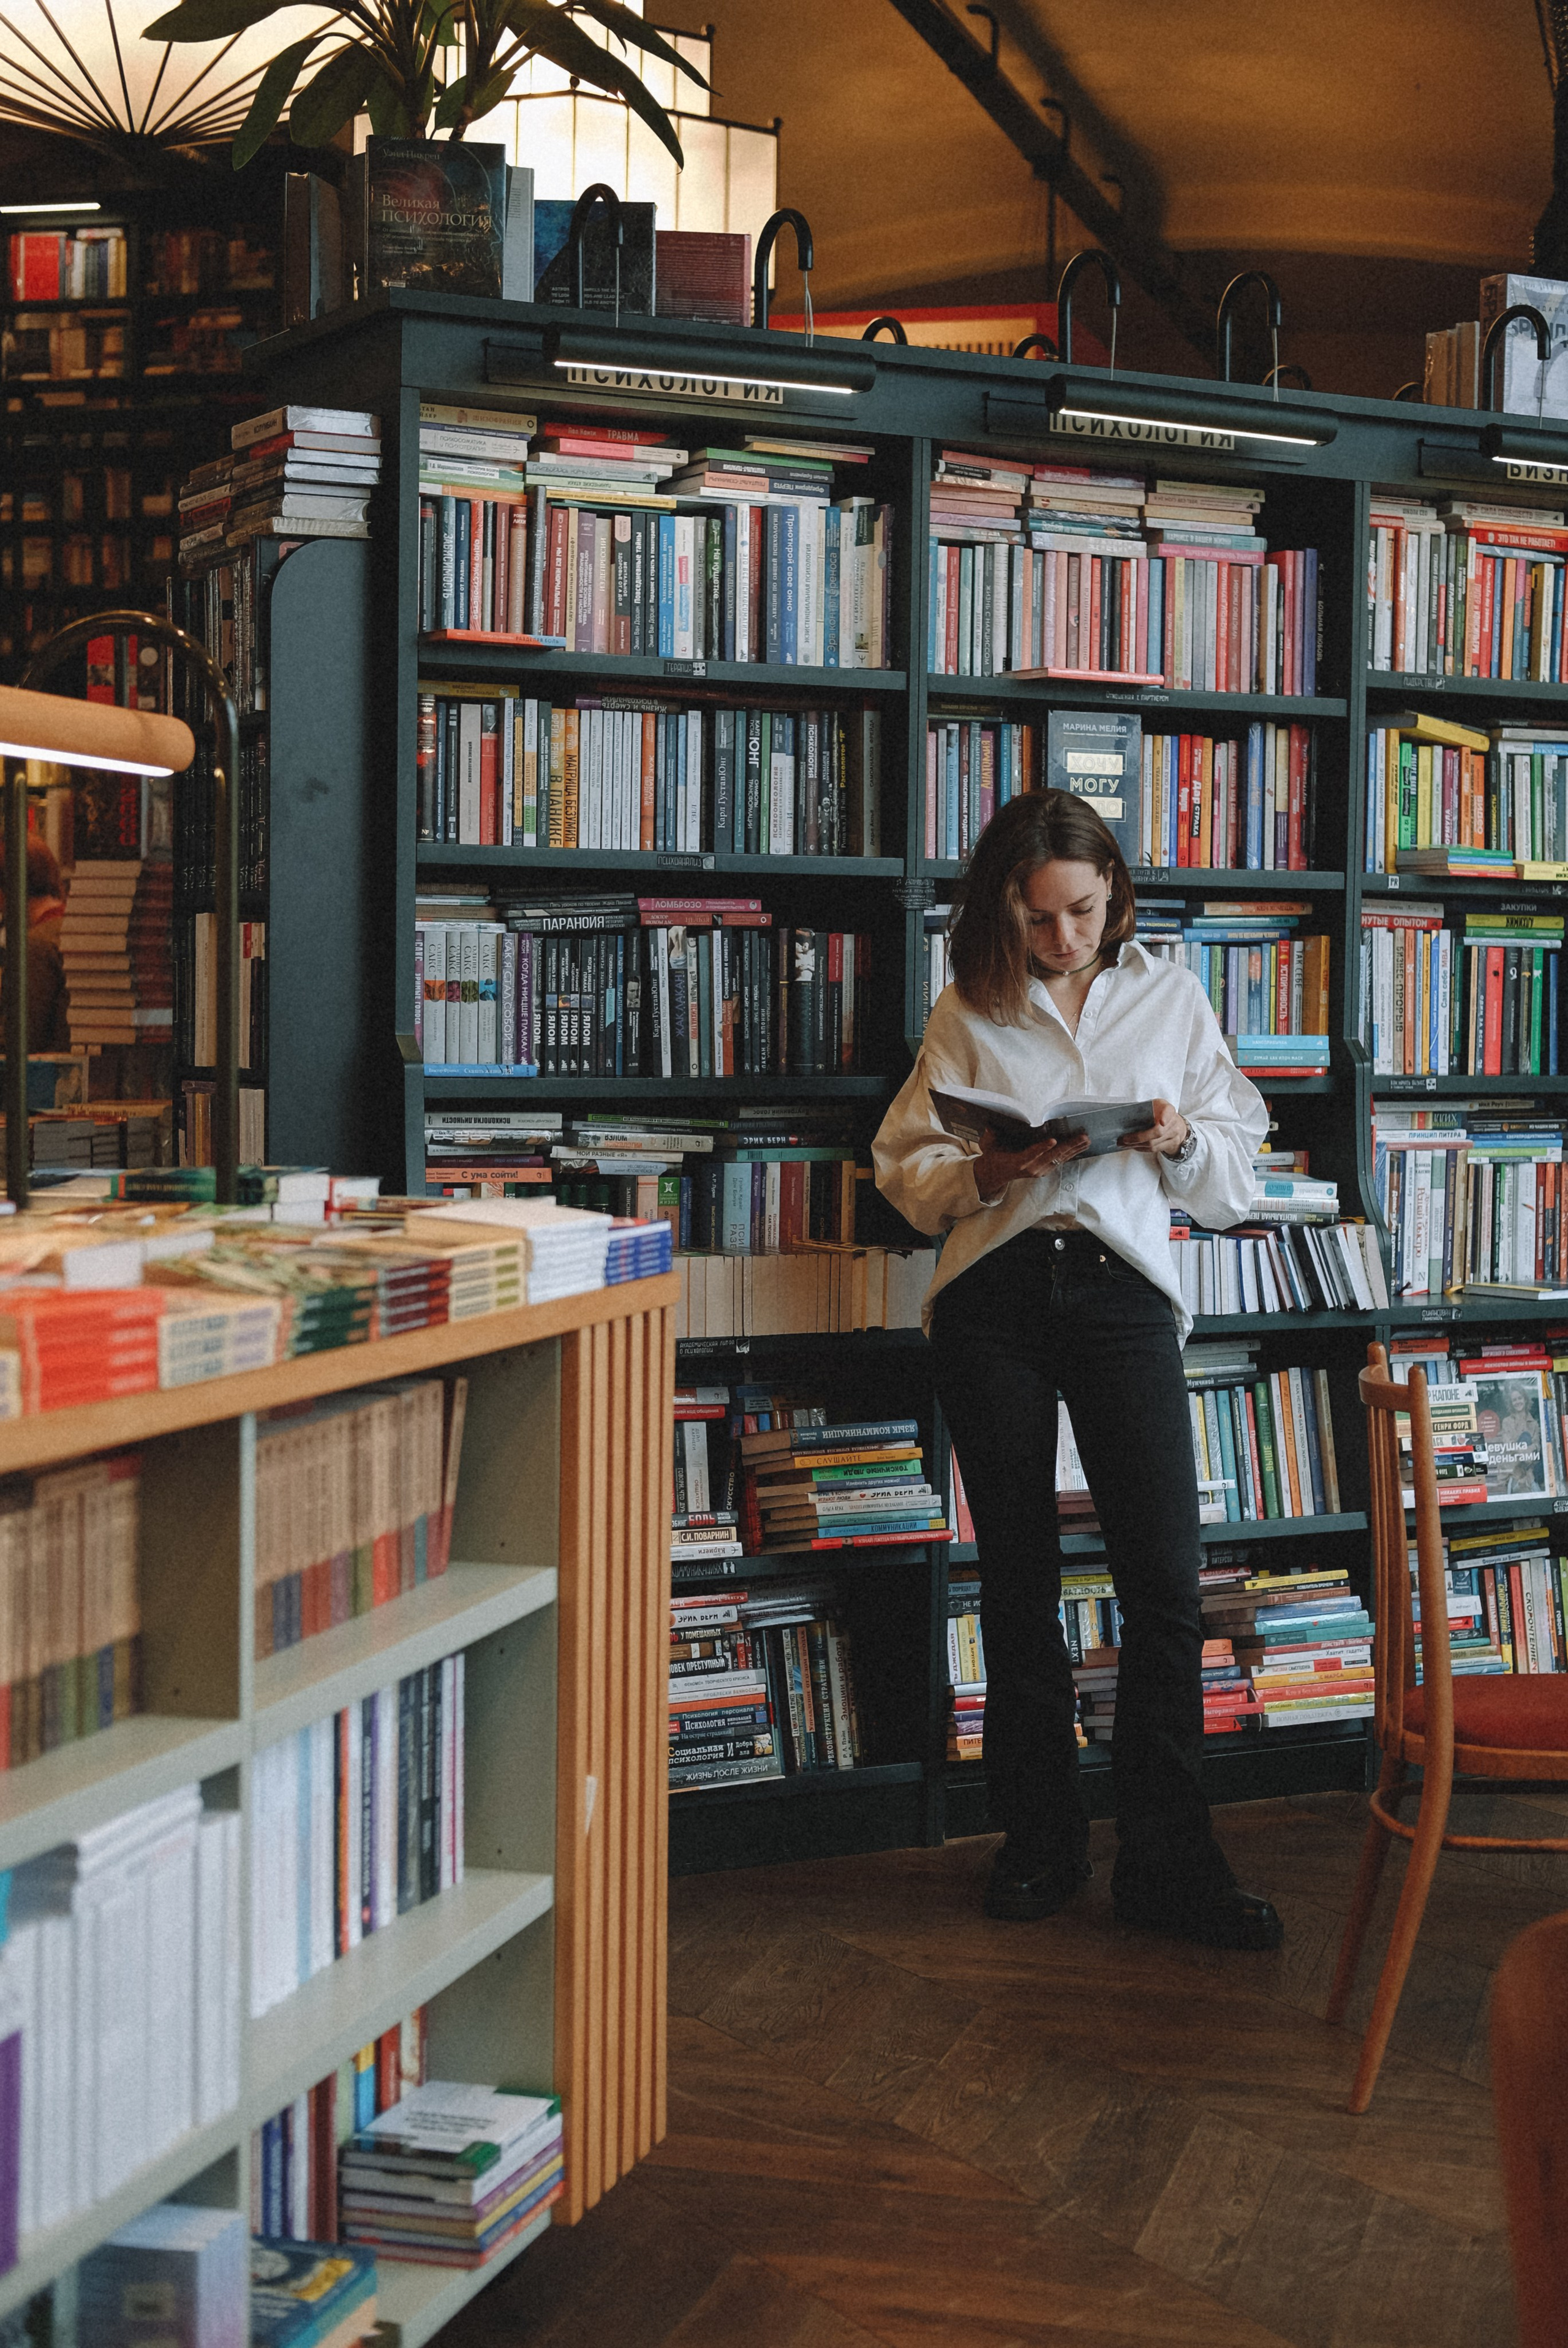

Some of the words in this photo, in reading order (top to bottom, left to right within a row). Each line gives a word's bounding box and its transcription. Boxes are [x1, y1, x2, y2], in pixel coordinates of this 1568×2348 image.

[382, 194, 440, 210] Великая
[382, 209, 493, 229] ПСИХОЛОГИЯ
[571, 367, 780, 402] ПСИХОЛОГИЯ
[472, 415, 522, 427] ШИЗОФРЕНИЯ
[607, 429, 639, 442] ТРАВМА
[1053, 413, 1231, 447] ПСИХОЛОГИЯ
[786, 514, 795, 564] Приоткрой
[714, 548, 721, 560] На
[442, 534, 454, 598] ЗАВИСИМОСТЬ
[827, 636, 837, 652] Эра
[666, 662, 692, 673] ТЕРАПИЯ
[601, 696, 652, 704] психоанализе
[1063, 723, 1097, 732] МАРИНА
[1099, 725, 1128, 733] МЕЛИЯ
[748, 737, 760, 768] ЮНГ
[981, 739, 991, 789] АНАТОМИЯ
[1071, 755, 1120, 772] ХОЧУ
[565, 754, 578, 796] МАТРИЦА
[1069, 777, 1120, 794] МОГУ
[1192, 779, 1202, 804] Дар
[549, 789, 562, 845] ПАНИКЕ
[565, 798, 577, 842] БЕЗУМИЯ
[717, 807, 728, 829] Карл
[1193, 804, 1201, 837] СТРАХА
[1474, 796, 1483, 835] ВИДЕО
[658, 856, 702, 867] ПСИХОАНАЛИЗ
[1390, 877, 1399, 887] PR
[655, 900, 702, 909] ЛОМБРОЗО
[1501, 902, 1538, 912] ЗАКУПКИ
[542, 915, 605, 931] ПАРАНОЙЯ
[1393, 918, 1428, 927] ОПЫТОМ
[503, 939, 514, 960] КАК
[1295, 949, 1304, 965] ТАК
[1294, 966, 1303, 989] СЕБЕ
[502, 972, 513, 1002] СТАЛ
[674, 974, 684, 1014] ЛАКАН
[1280, 964, 1289, 1021] УСТОЙЧИВОСТЬ
[1395, 945, 1404, 1032] БИЗНЕС-ПРОРЫВ
[502, 1002, 513, 1041] СОБОЙ
[676, 1014, 685, 1038] ЖАК
[520, 1014, 529, 1052] ПЛАКАЛ
[548, 1014, 556, 1046] ЯЛОМ
[442, 1115, 472, 1124] ЛИЧНОСТИ
[473, 1116, 511, 1125] ПСИХОЛОГИЯ
[489, 1169, 519, 1179] сойти!
[1261, 1212, 1297, 1221] МЕНТАЛЬНАЯ
[1186, 1377, 1215, 1388] Мужчиной
[1433, 1388, 1460, 1402] КАПОНЕ
[822, 1427, 891, 1440] КОММУНИКАЦИИ
[892, 1425, 916, 1434] ЯЗЫК
[1434, 1422, 1451, 1432] ГЕНРИ
[1452, 1421, 1469, 1430] ФОРД
[816, 1454, 862, 1466] СЛУШАЙТЕ
[1263, 1444, 1274, 1471] ВЫШЕ
[1489, 1451, 1541, 1465] деньгами
[694, 1529, 730, 1540] ПОВАРНИН
[870, 1521, 918, 1533] КОММУНИКАЦИИ
[685, 1628, 722, 1640] ПОМЕШАННЫХ
[1526, 1591, 1537, 1664] СКОРОЧТЕНИЕ
[687, 1656, 726, 1672] ПРЕСТУПНЫЙ
[835, 1640, 845, 1675] работа
[839, 1684, 849, 1721] Эмоции
[682, 1710, 718, 1720] Психология
[722, 1707, 754, 1717] персонала
[685, 1772, 712, 1782] ЖИЗНЬ
[712, 1768, 740, 1779] ПОСЛЕ
[741, 1764, 769, 1775] ЖИЗНИ
